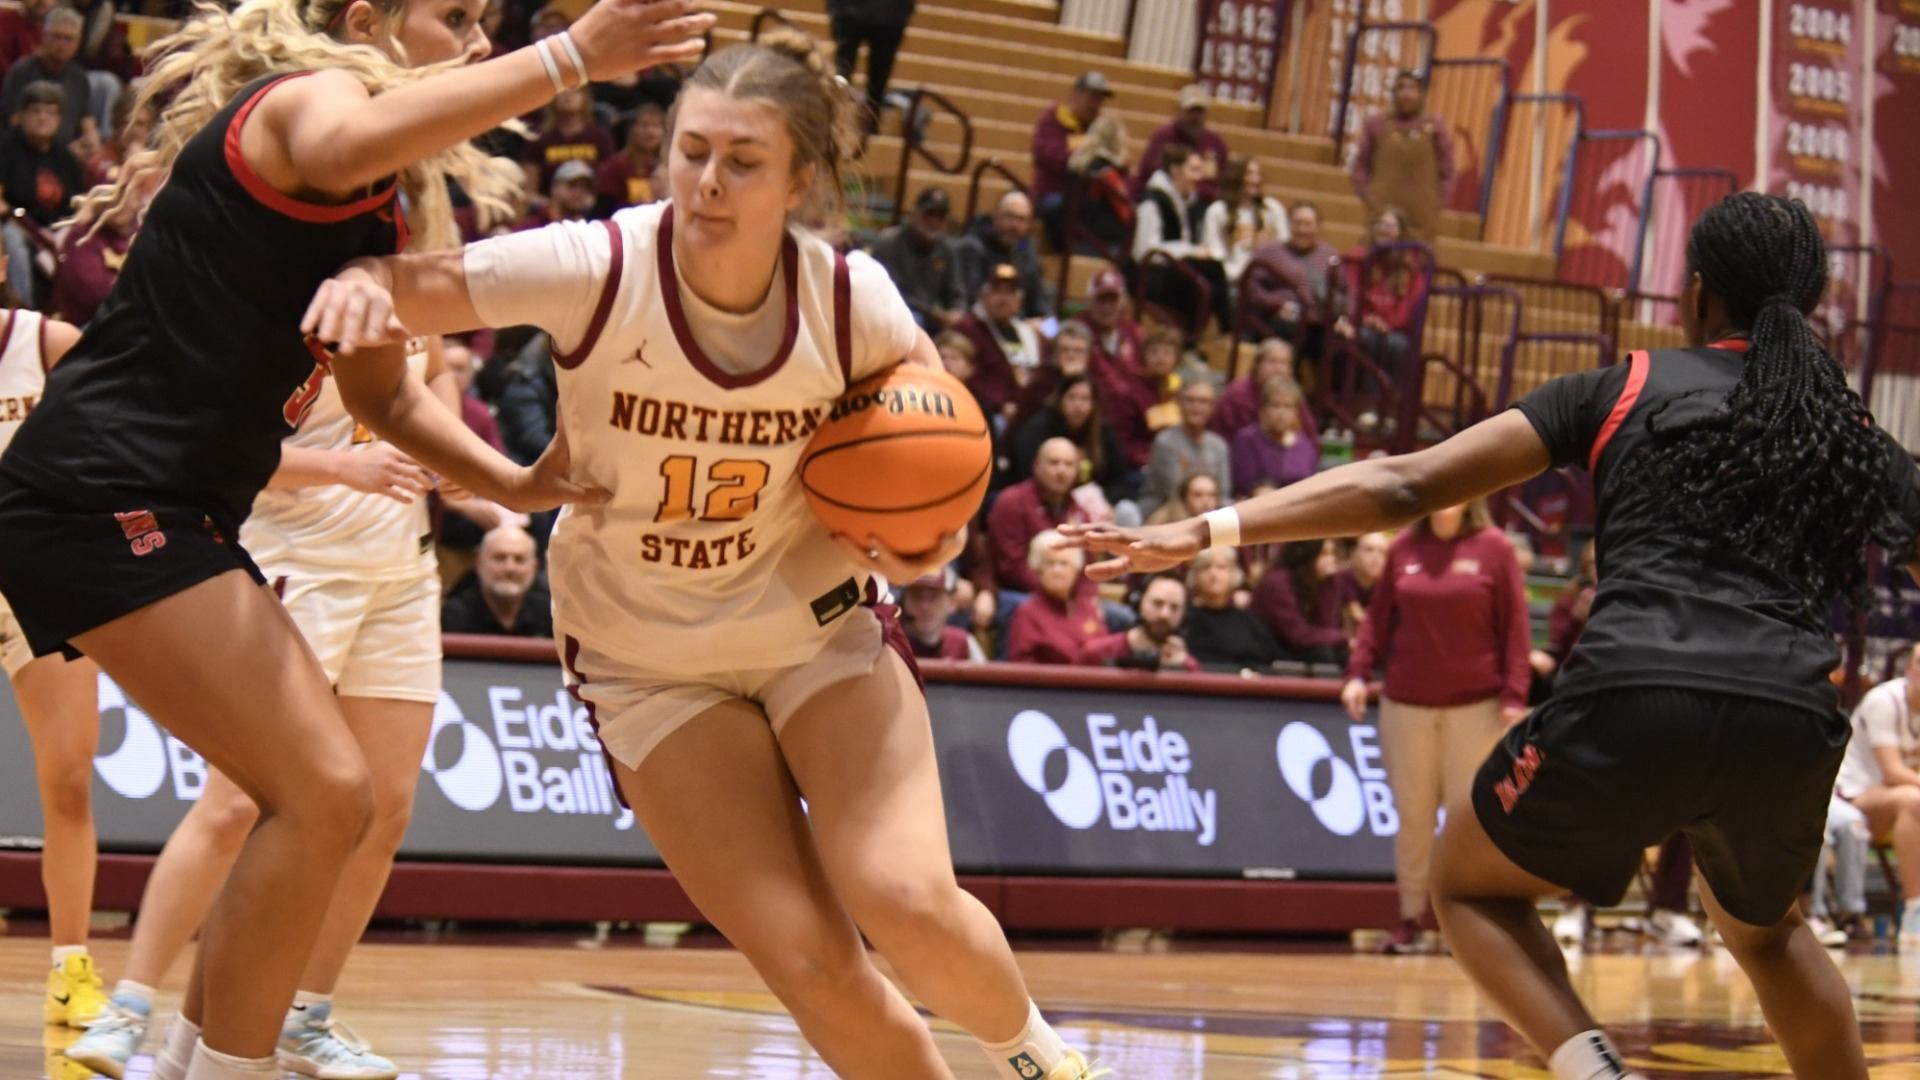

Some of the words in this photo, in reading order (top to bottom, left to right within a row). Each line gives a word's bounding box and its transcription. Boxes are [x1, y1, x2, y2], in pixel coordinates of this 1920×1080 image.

[1789, 4, 1851, 43] 2004
[1788, 62, 1850, 103] 2005
[609, 392, 821, 445] NORTHERN
[654, 454, 771, 522] 12
[641, 528, 756, 570] STATE
[488, 686, 602, 751] Eide
[1086, 713, 1192, 774] Eide
[1101, 773, 1216, 846] Bailly
